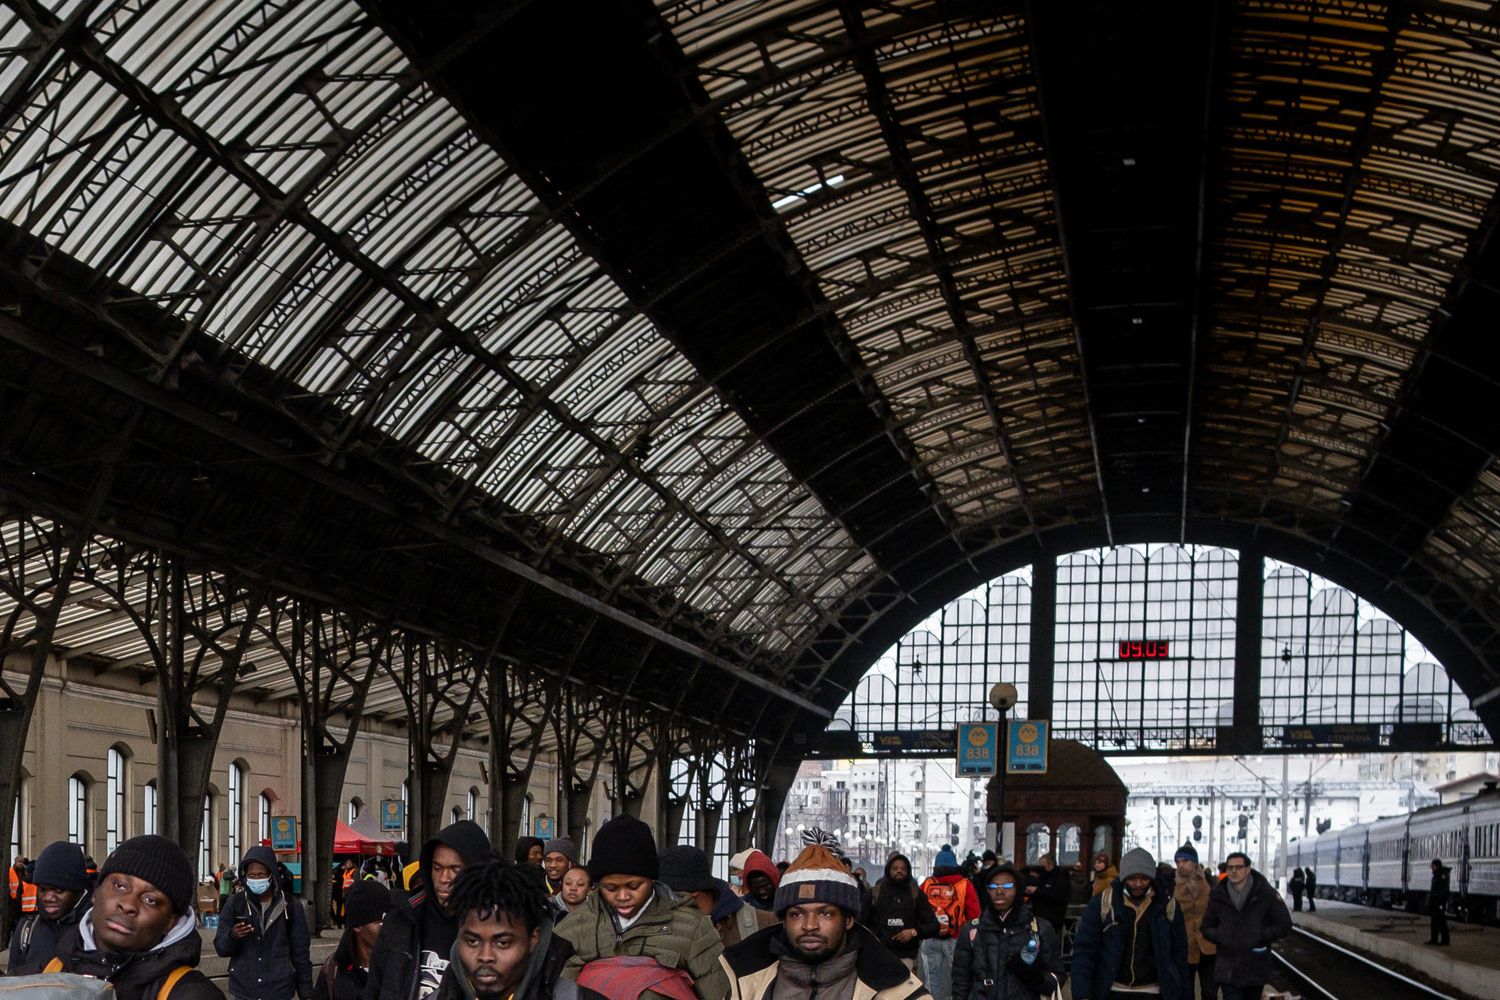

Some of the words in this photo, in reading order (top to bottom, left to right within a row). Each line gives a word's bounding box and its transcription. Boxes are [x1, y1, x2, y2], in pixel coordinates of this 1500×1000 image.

[1119, 640, 1169, 658] 09.03
[966, 747, 989, 760] 838
[1016, 744, 1039, 756] 838
